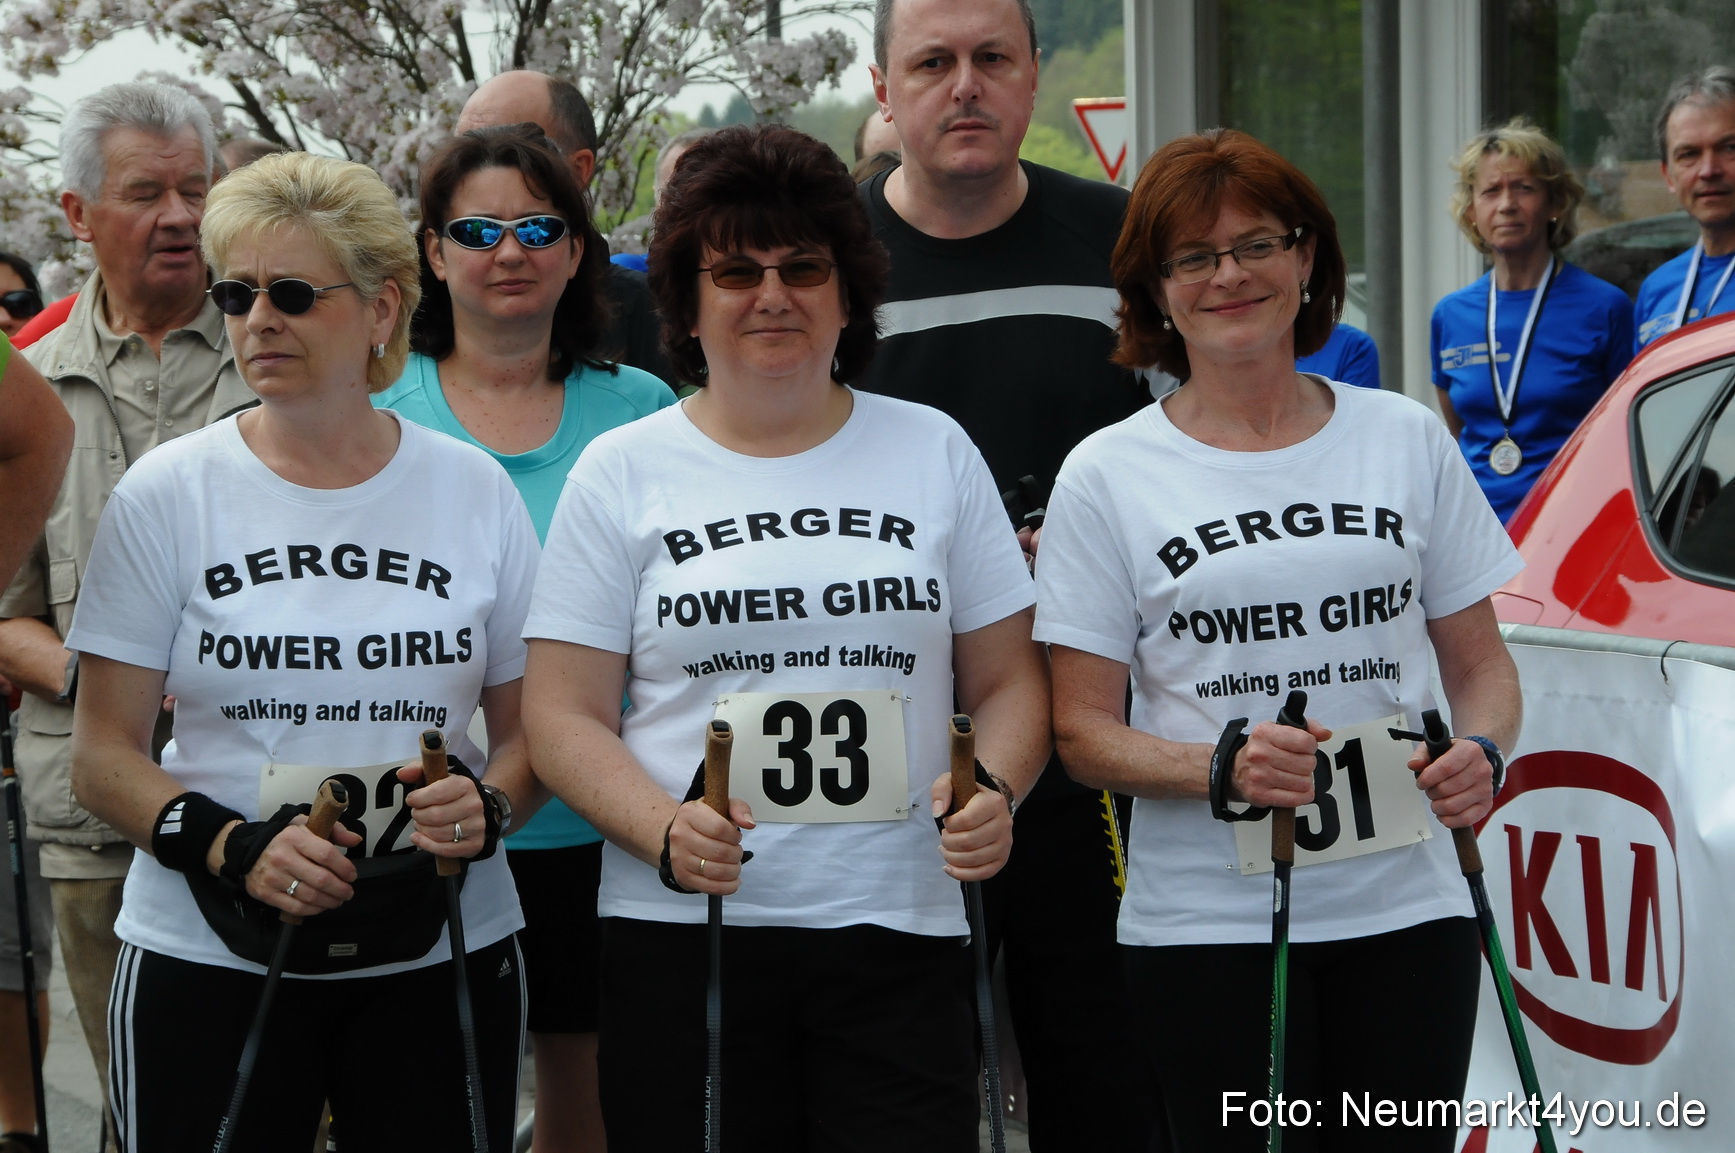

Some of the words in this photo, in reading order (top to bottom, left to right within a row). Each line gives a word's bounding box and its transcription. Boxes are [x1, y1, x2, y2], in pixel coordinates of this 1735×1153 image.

[663, 508, 915, 565] BERGER
[1157, 503, 1405, 579] BERGER
[205, 544, 452, 600] BERGER
[658, 588, 809, 628] POWER
[823, 578, 941, 620] GIRLS
[1169, 601, 1308, 643] POWER
[1320, 576, 1413, 633] GIRLS
[199, 629, 343, 670] POWER
[358, 628, 472, 670] GIRLS
[683, 651, 775, 679] walking
[784, 646, 830, 667] and
[839, 645, 917, 676] talking
[1196, 674, 1280, 700] walking
[1287, 663, 1331, 690] and
[221, 699, 307, 726] walking
[316, 700, 361, 722] and
[369, 700, 447, 728] talking
[762, 700, 869, 807] 33
[1503, 823, 1668, 1003] KIA
